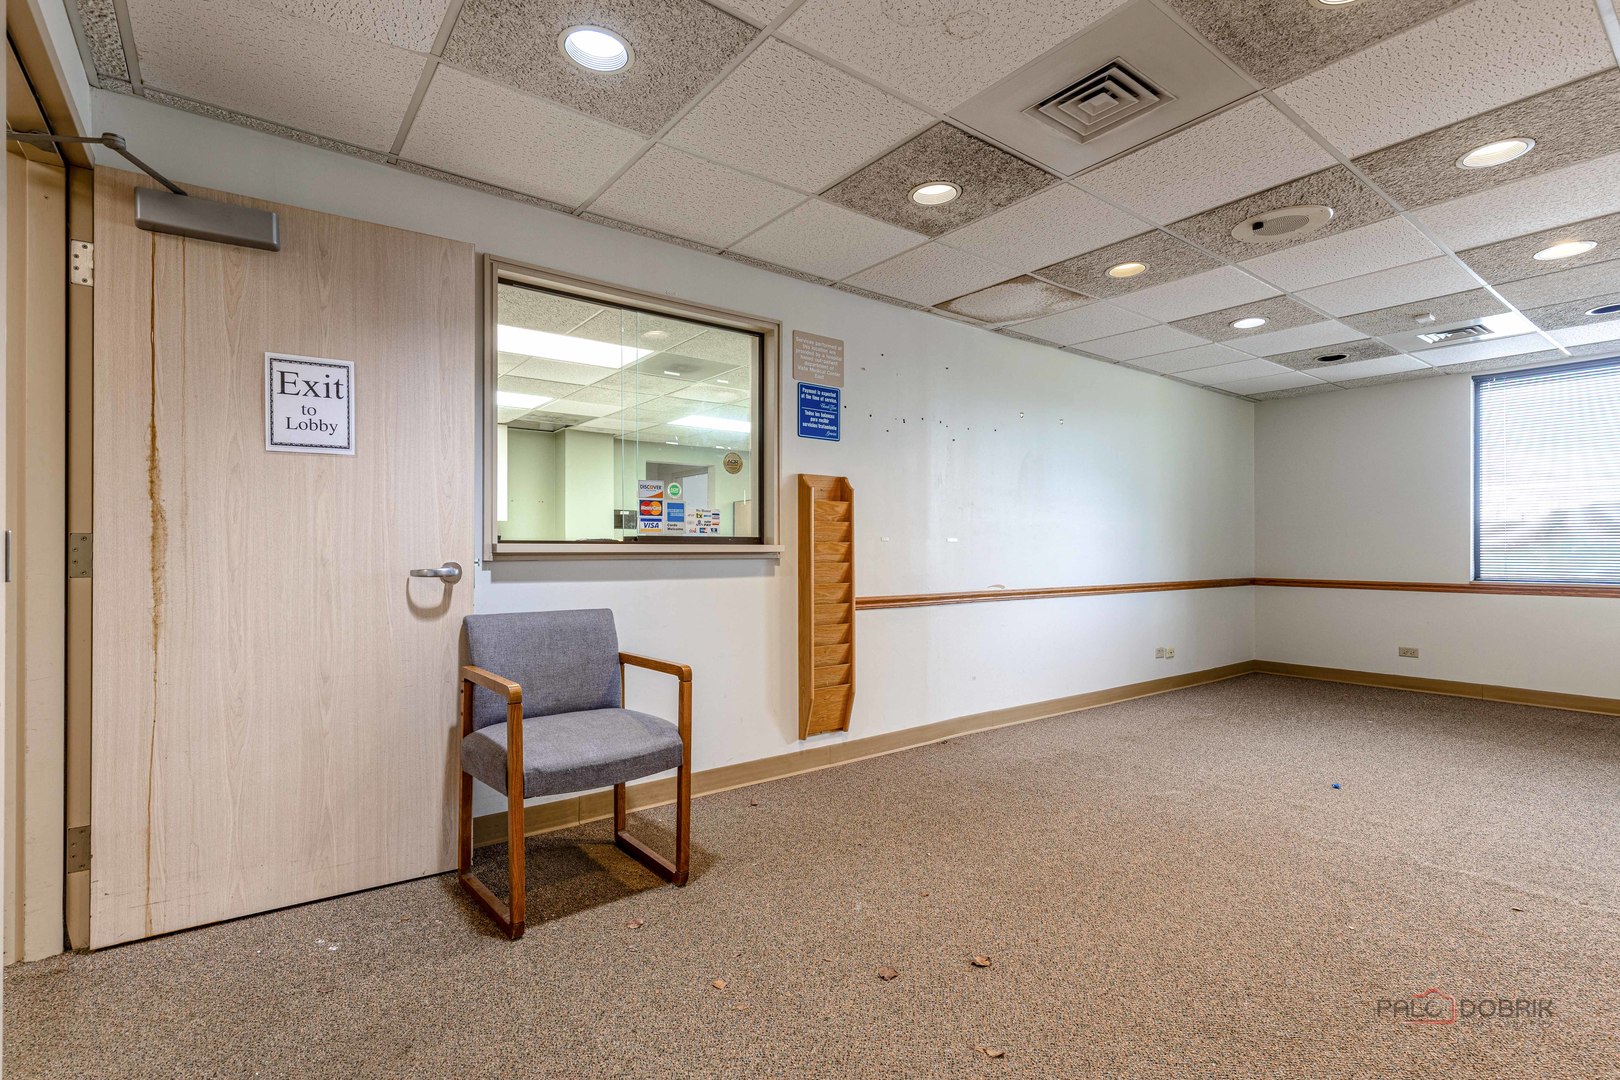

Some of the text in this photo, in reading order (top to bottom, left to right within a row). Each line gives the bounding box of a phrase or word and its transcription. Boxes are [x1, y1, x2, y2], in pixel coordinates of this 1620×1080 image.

[796, 336, 814, 344] Services
[276, 370, 344, 400] Exit
[301, 404, 317, 416] to
[286, 416, 338, 435] Lobby
